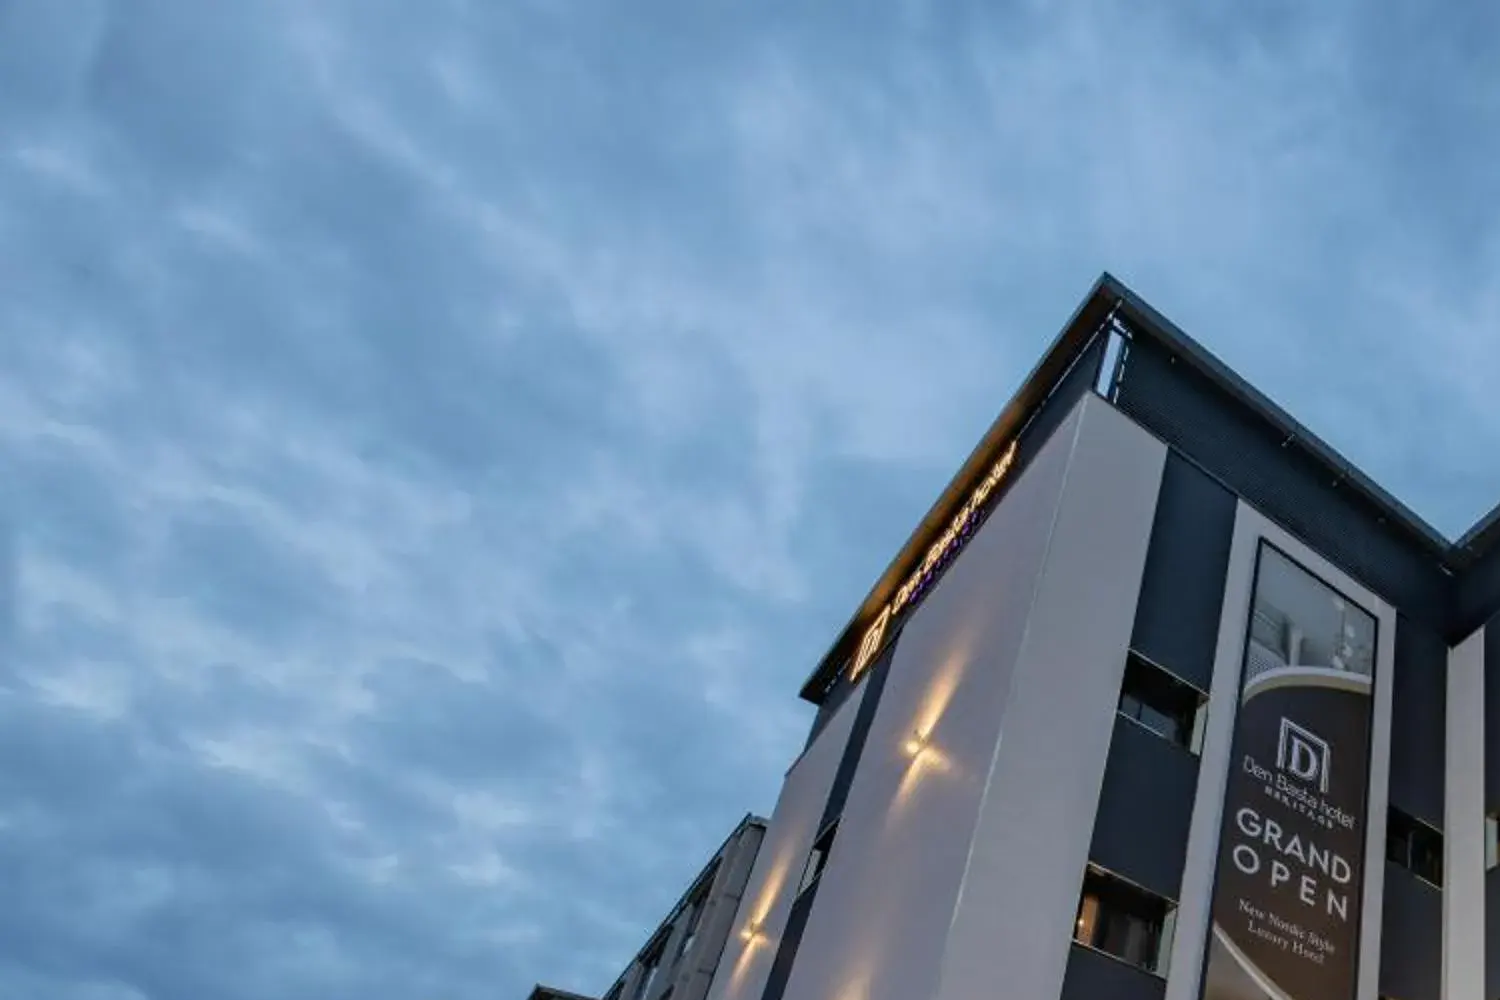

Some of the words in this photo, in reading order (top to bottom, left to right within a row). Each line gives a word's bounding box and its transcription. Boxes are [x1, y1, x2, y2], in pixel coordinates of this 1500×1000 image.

[1243, 754, 1273, 784] Den
[1320, 799, 1356, 830] hotel
[1232, 844, 1348, 923] OPEN
[1236, 807, 1352, 884] GRAND
[1238, 898, 1265, 920] New
